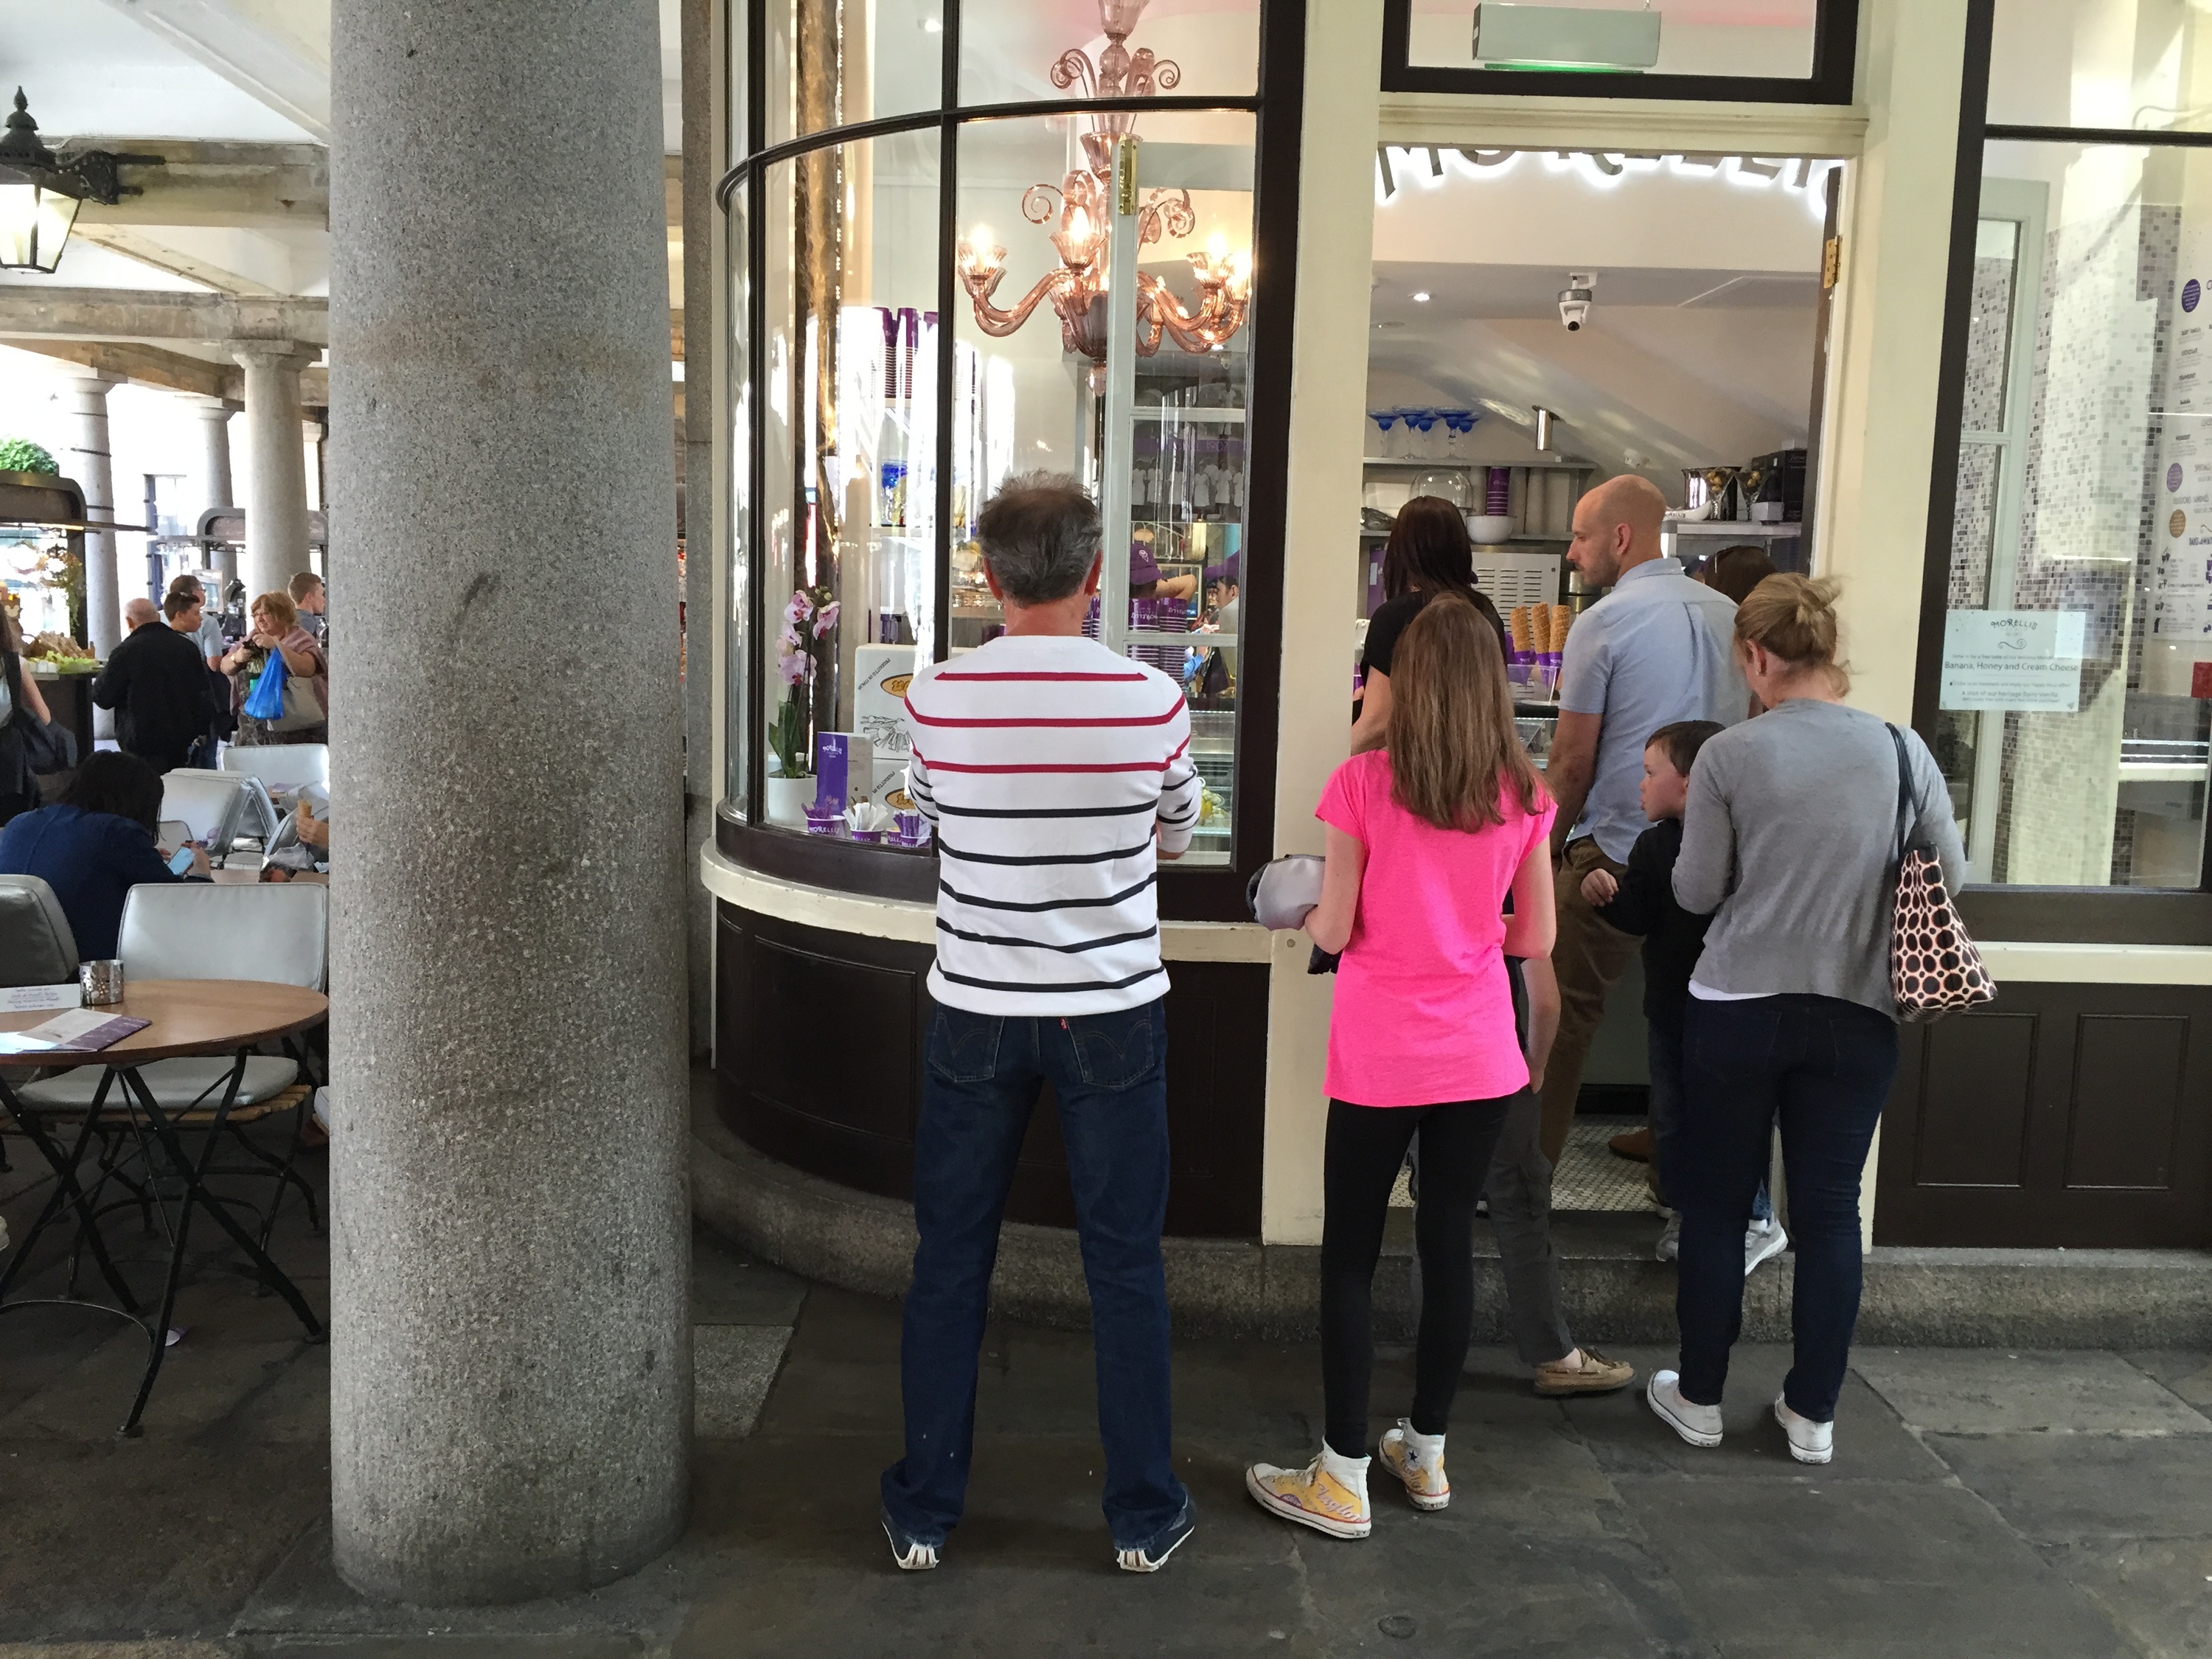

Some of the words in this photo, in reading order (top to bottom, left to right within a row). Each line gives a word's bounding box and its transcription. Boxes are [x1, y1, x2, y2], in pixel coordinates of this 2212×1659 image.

[1944, 661, 1975, 669] Banana,
[1977, 662, 2003, 671] Honey
[2049, 663, 2079, 671] Cheese
